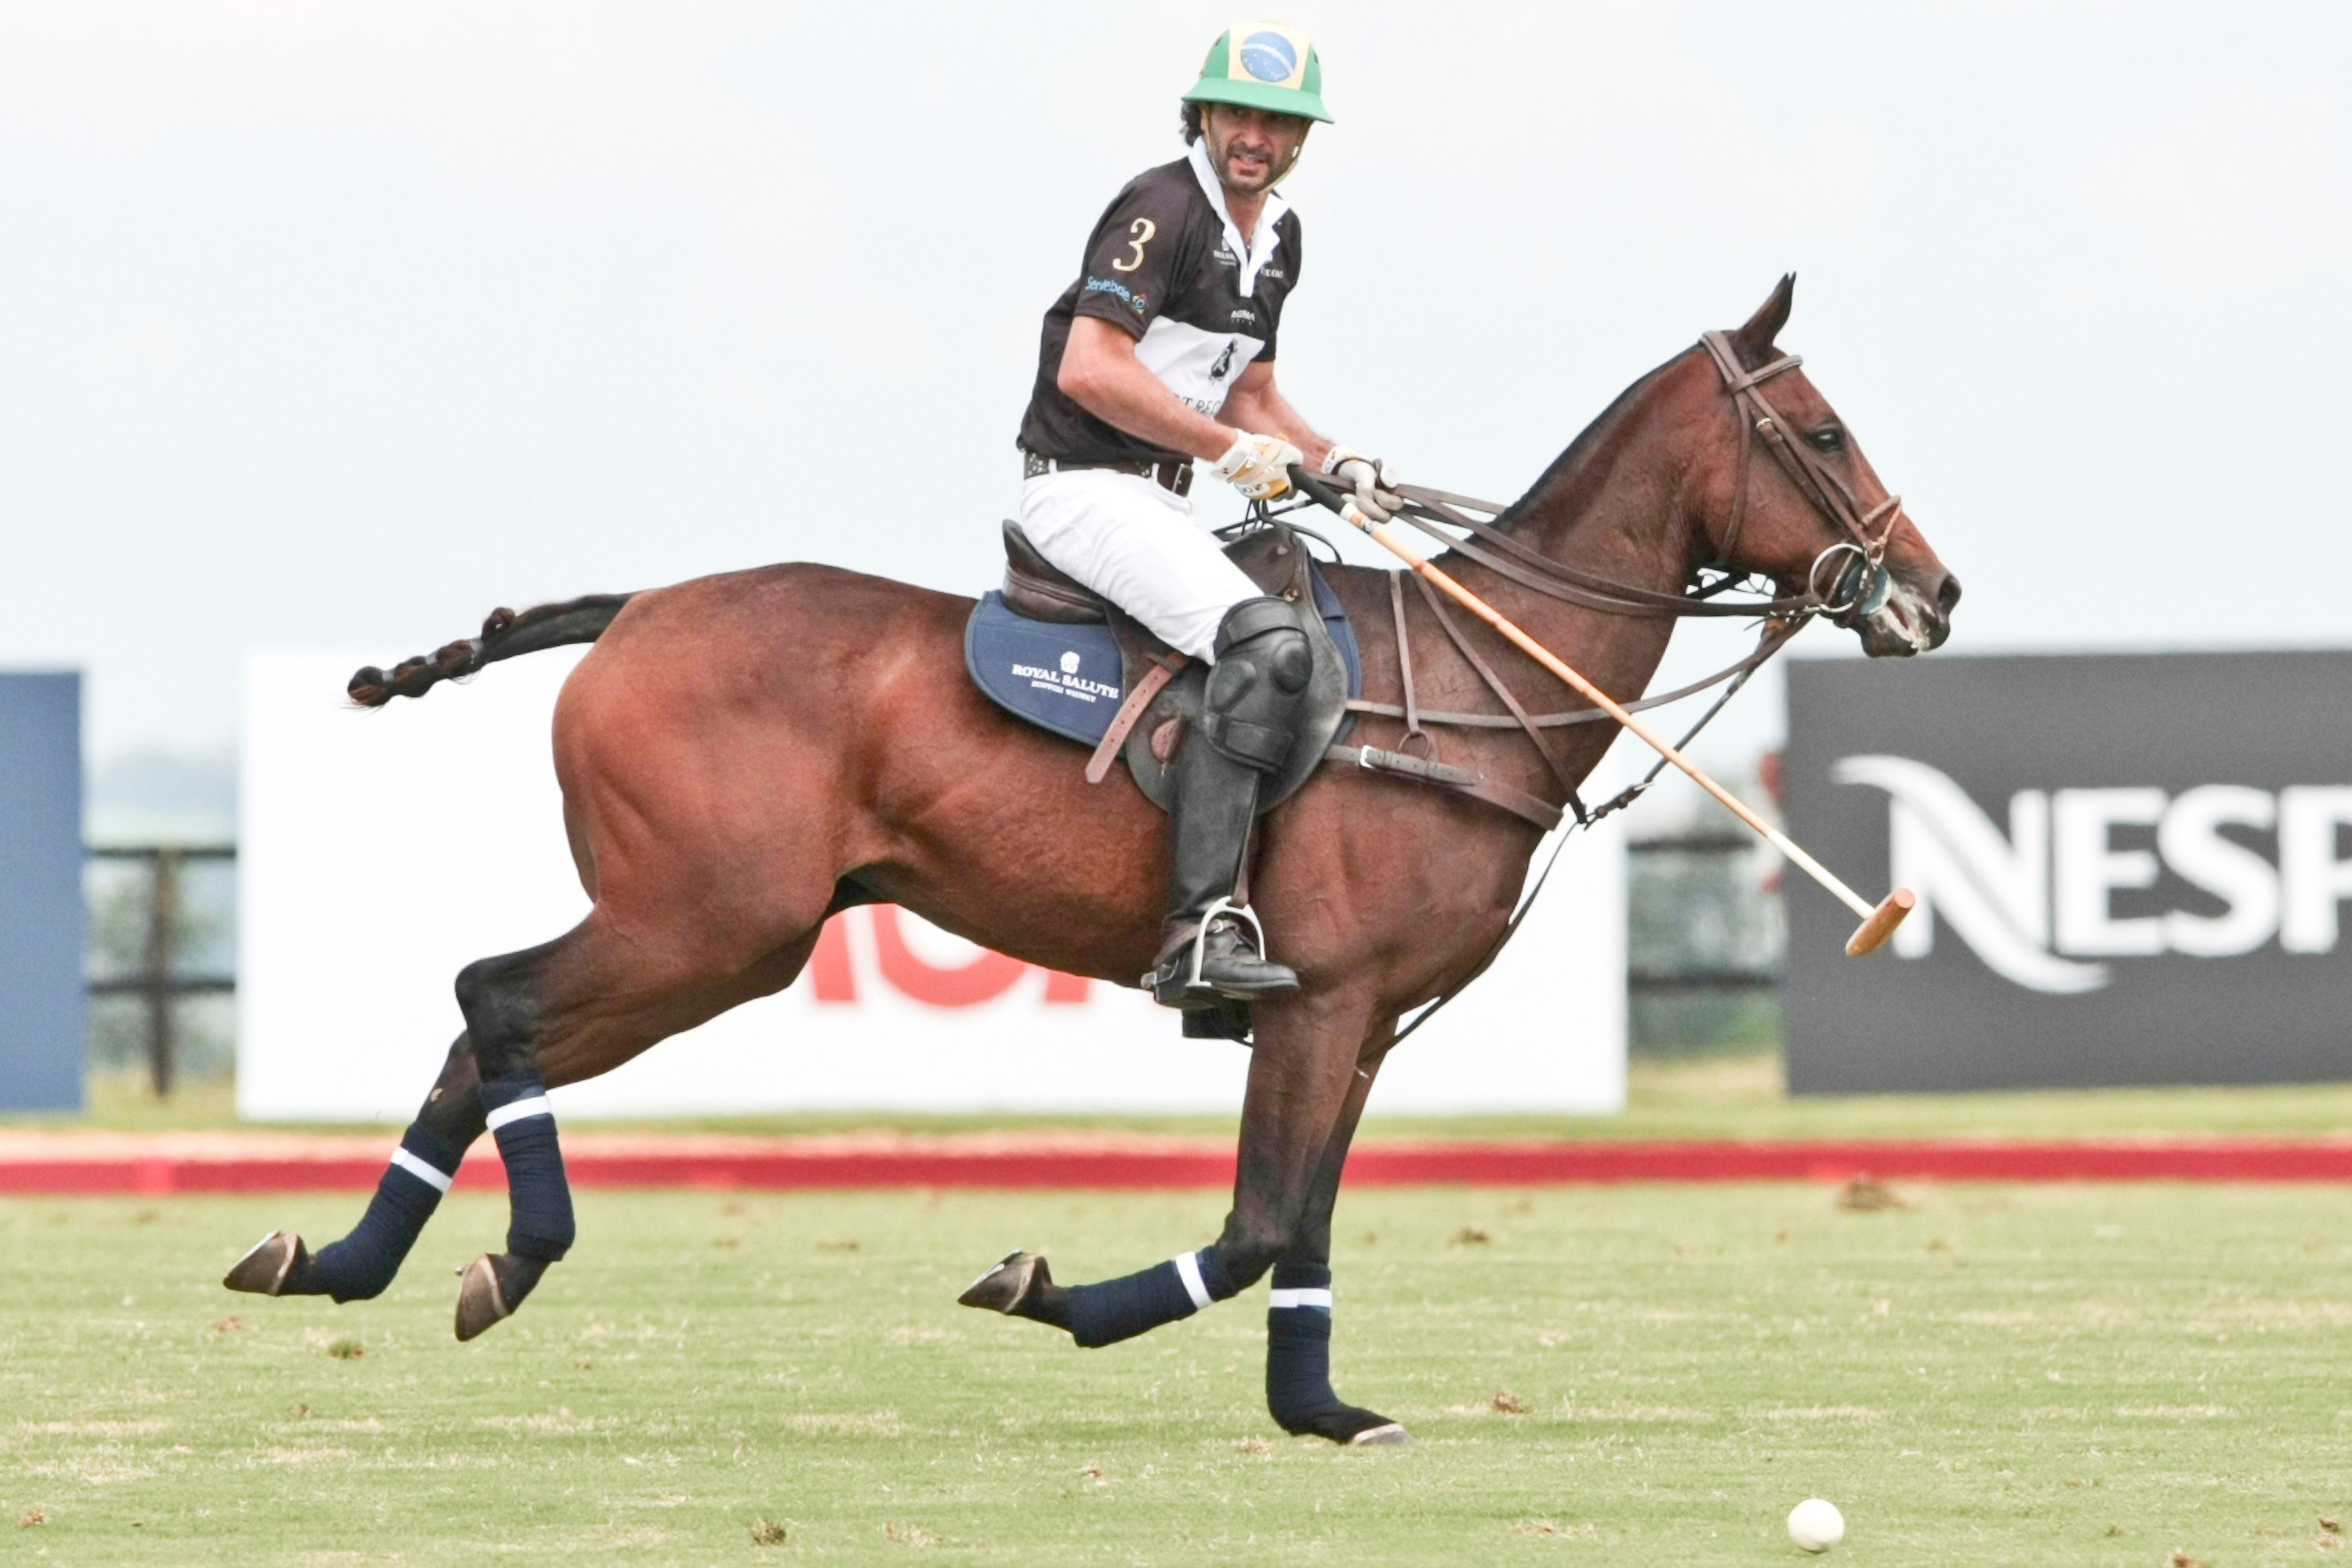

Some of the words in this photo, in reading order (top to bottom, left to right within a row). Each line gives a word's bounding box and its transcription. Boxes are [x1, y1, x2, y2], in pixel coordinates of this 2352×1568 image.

[1112, 217, 1156, 272] 3
[1012, 663, 1061, 683] ROYAL
[1062, 674, 1119, 699] SALUTE
